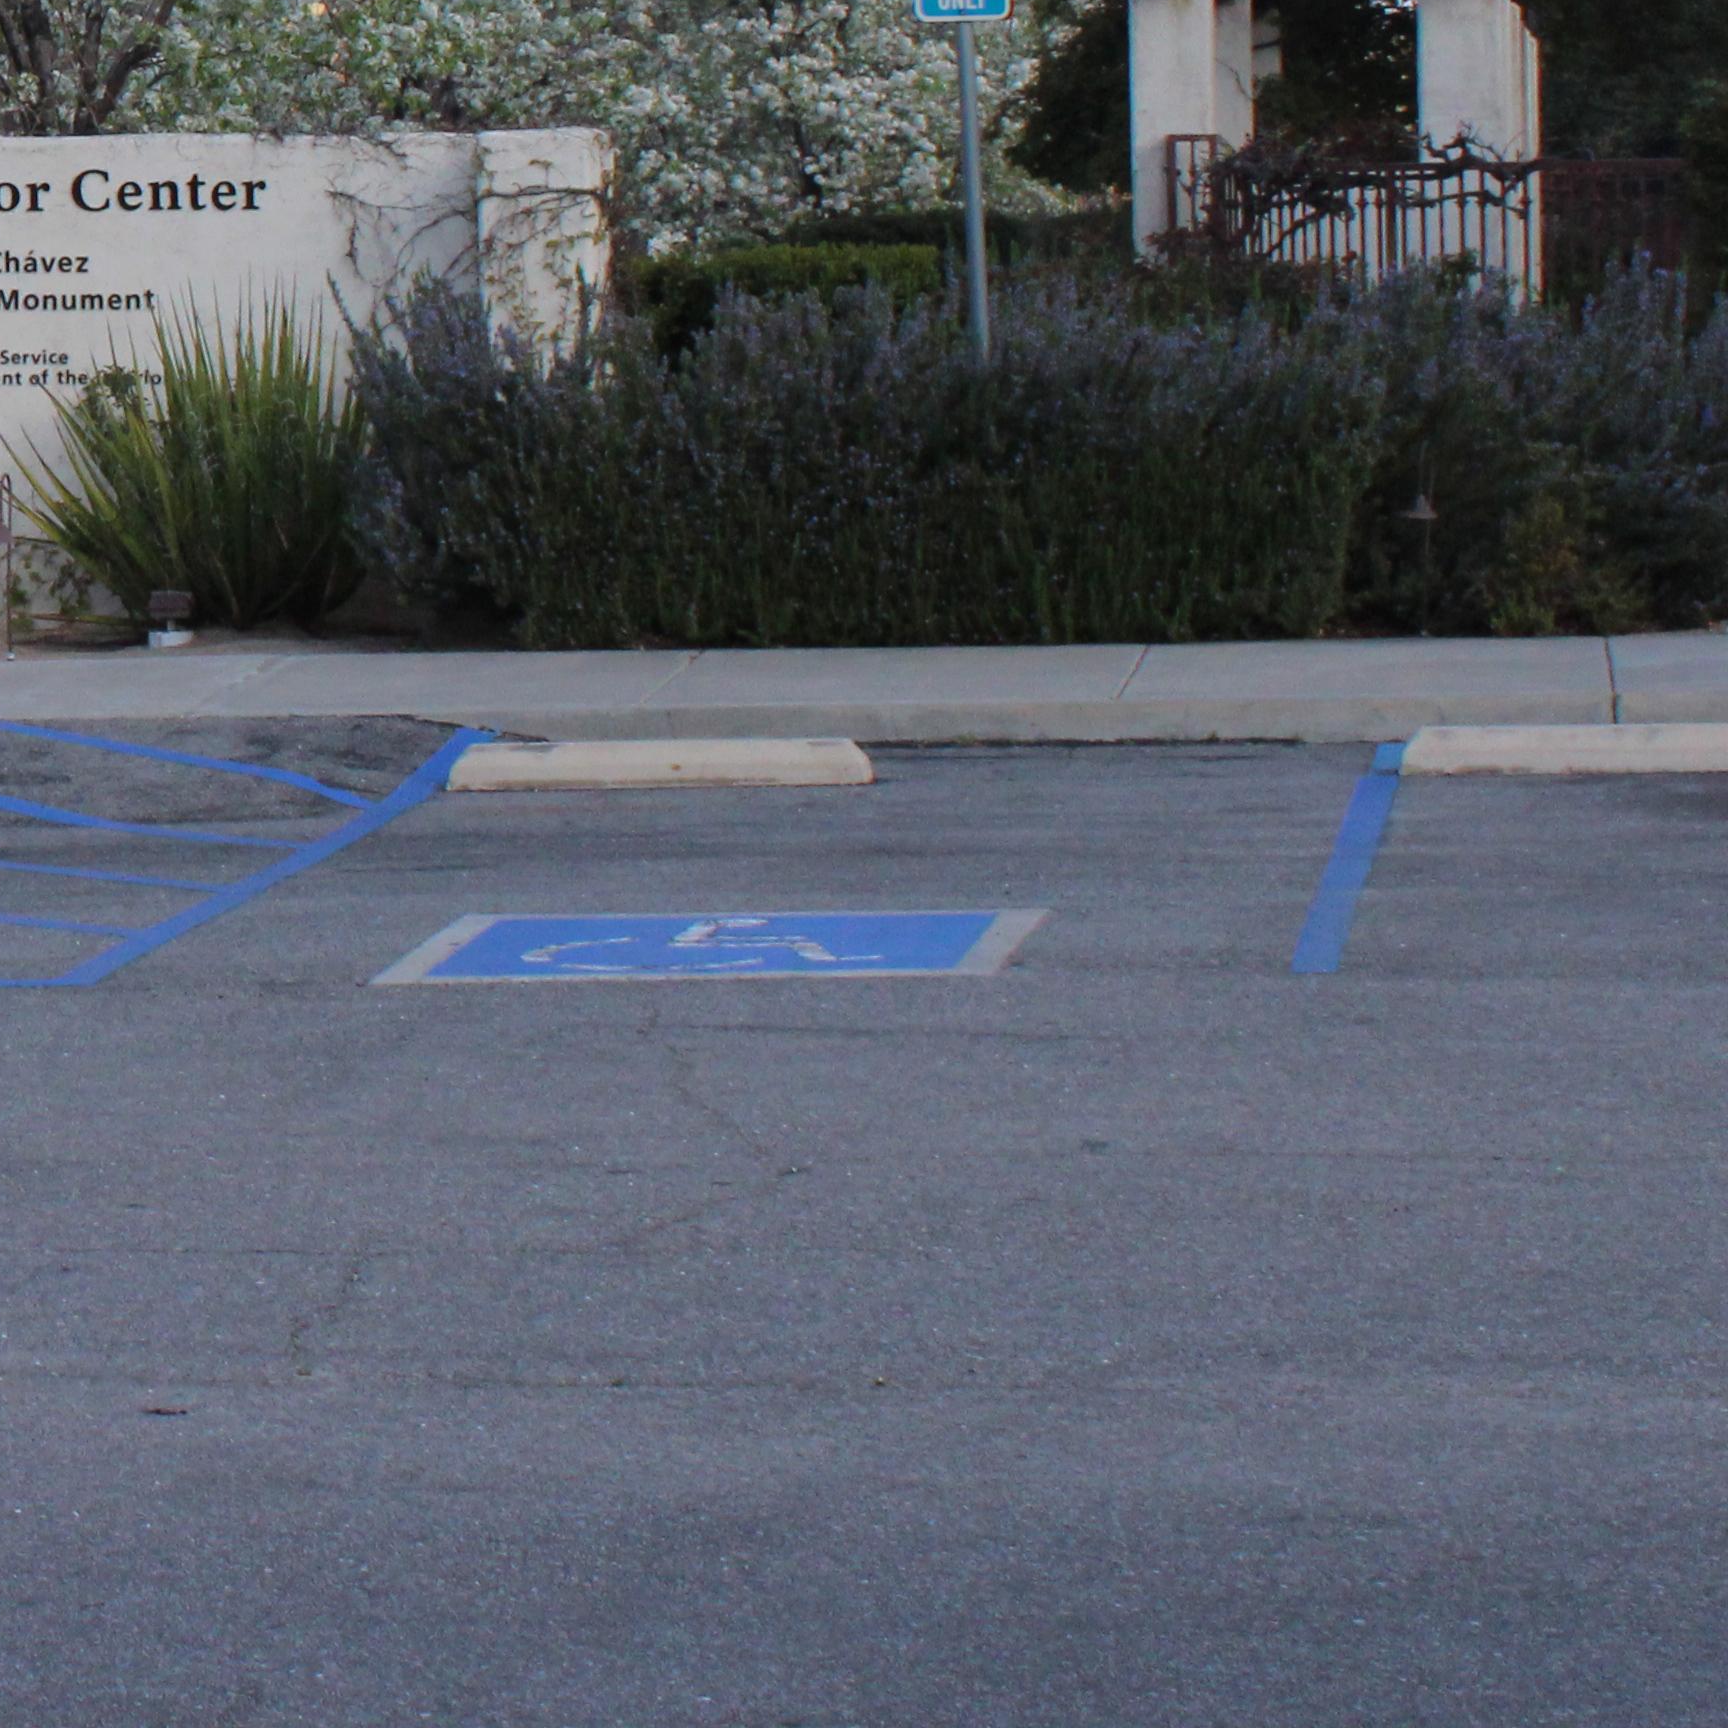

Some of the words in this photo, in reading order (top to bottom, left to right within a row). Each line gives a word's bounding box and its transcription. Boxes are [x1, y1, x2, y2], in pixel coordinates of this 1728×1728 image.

[70, 168, 267, 212] Center
[0, 349, 69, 365] Service
[29, 369, 50, 385] of
[57, 369, 88, 385] the
